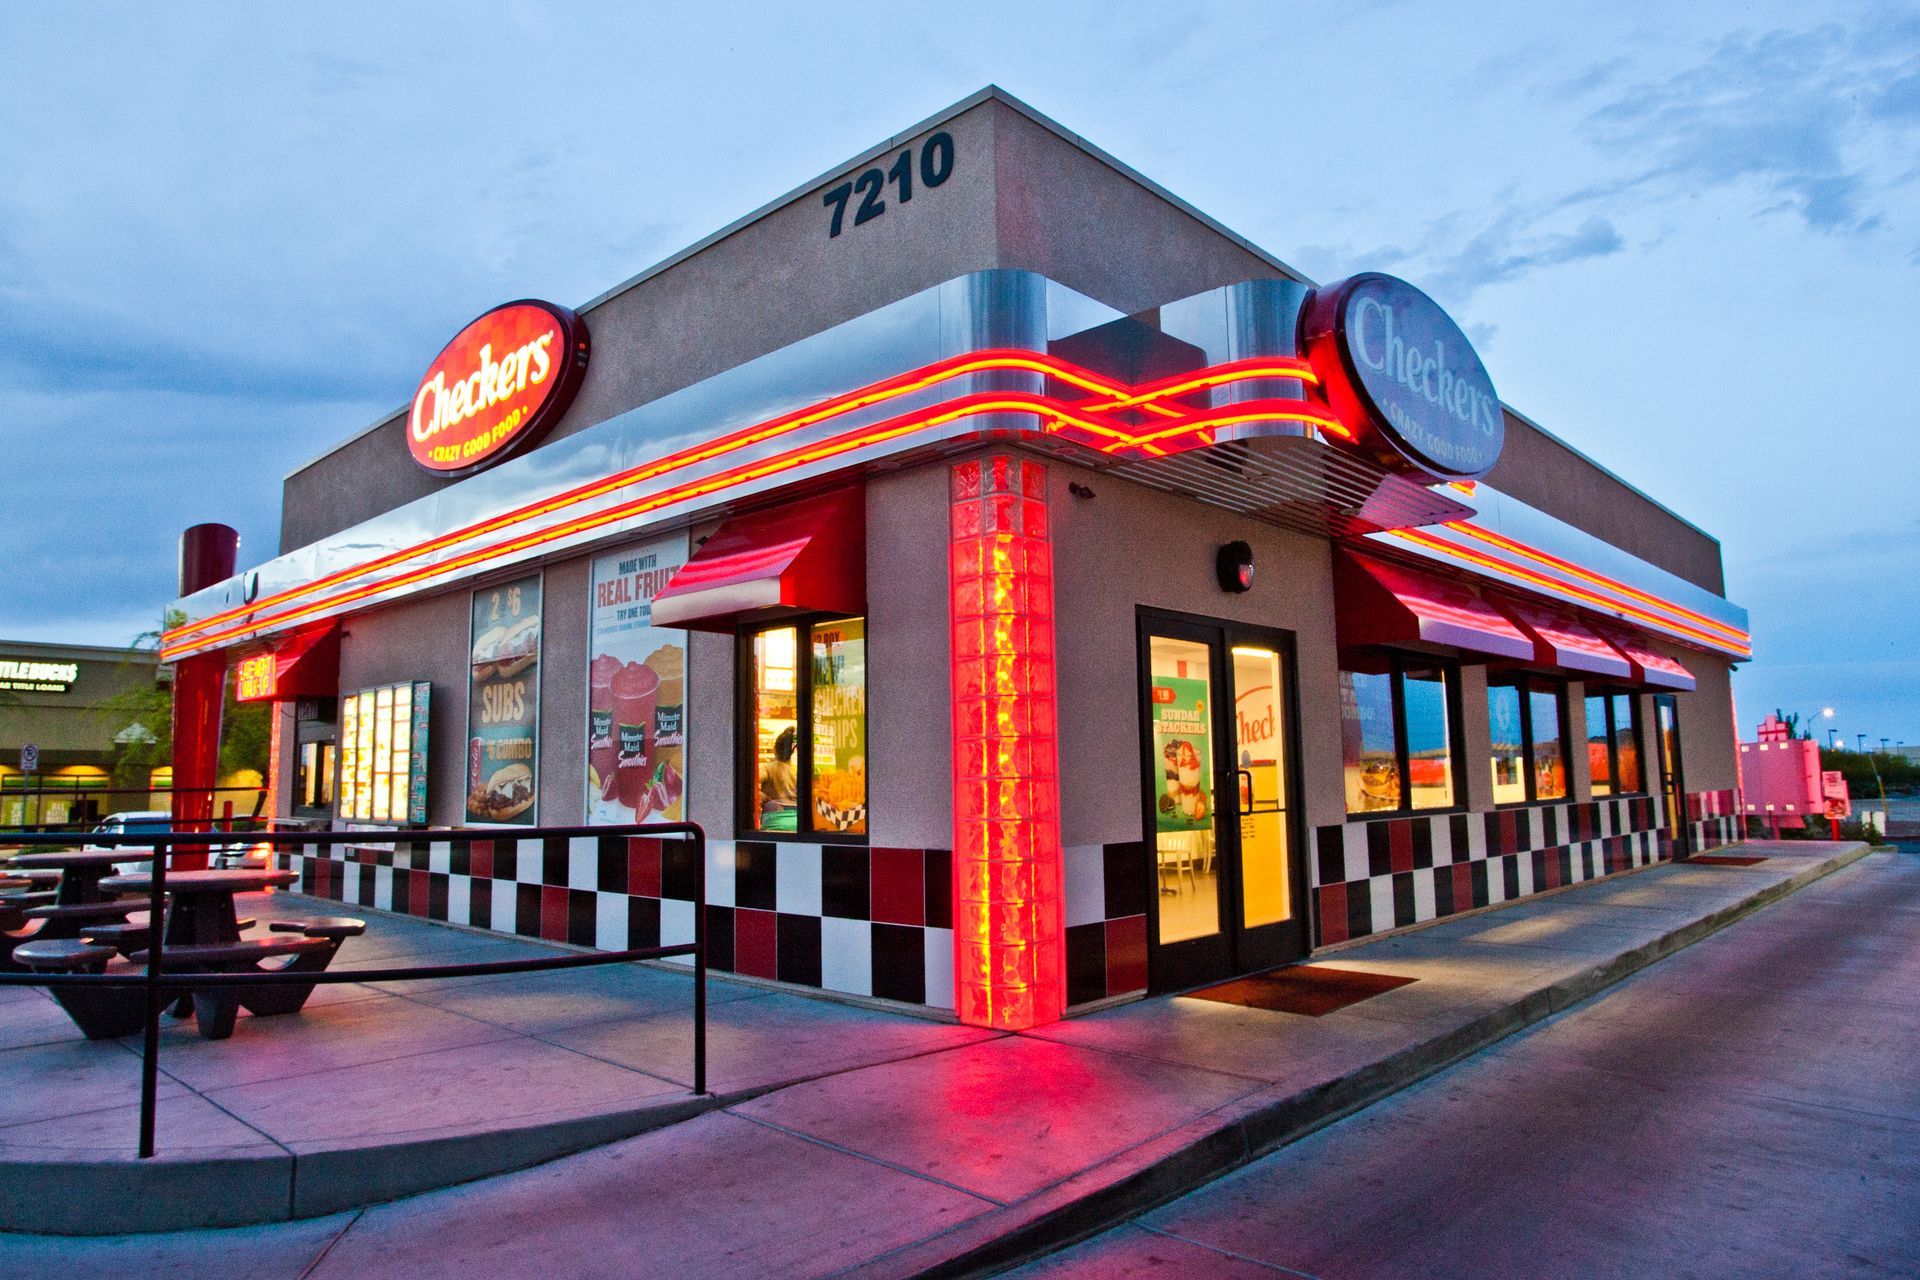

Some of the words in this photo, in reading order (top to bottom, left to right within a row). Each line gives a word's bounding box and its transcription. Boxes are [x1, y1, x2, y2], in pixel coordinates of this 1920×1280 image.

[823, 132, 954, 238] 7210
[1354, 297, 1495, 437] Checkers
[412, 330, 554, 442] Checkers
[433, 444, 461, 462] CRAZY
[463, 431, 490, 457] GOOD
[492, 408, 521, 443] FOOD
[619, 559, 637, 575] MADE
[639, 554, 656, 570] WITH
[597, 577, 631, 608] REAL
[617, 609, 627, 620] TRY
[628, 607, 638, 618] ONE
[482, 681, 525, 723] SUBS
[596, 726, 608, 735] Maid
[660, 721, 677, 731] Maid
[1155, 721, 1206, 734] STACKERS
[496, 738, 531, 759] COMBO
[624, 742, 640, 752] Maid
